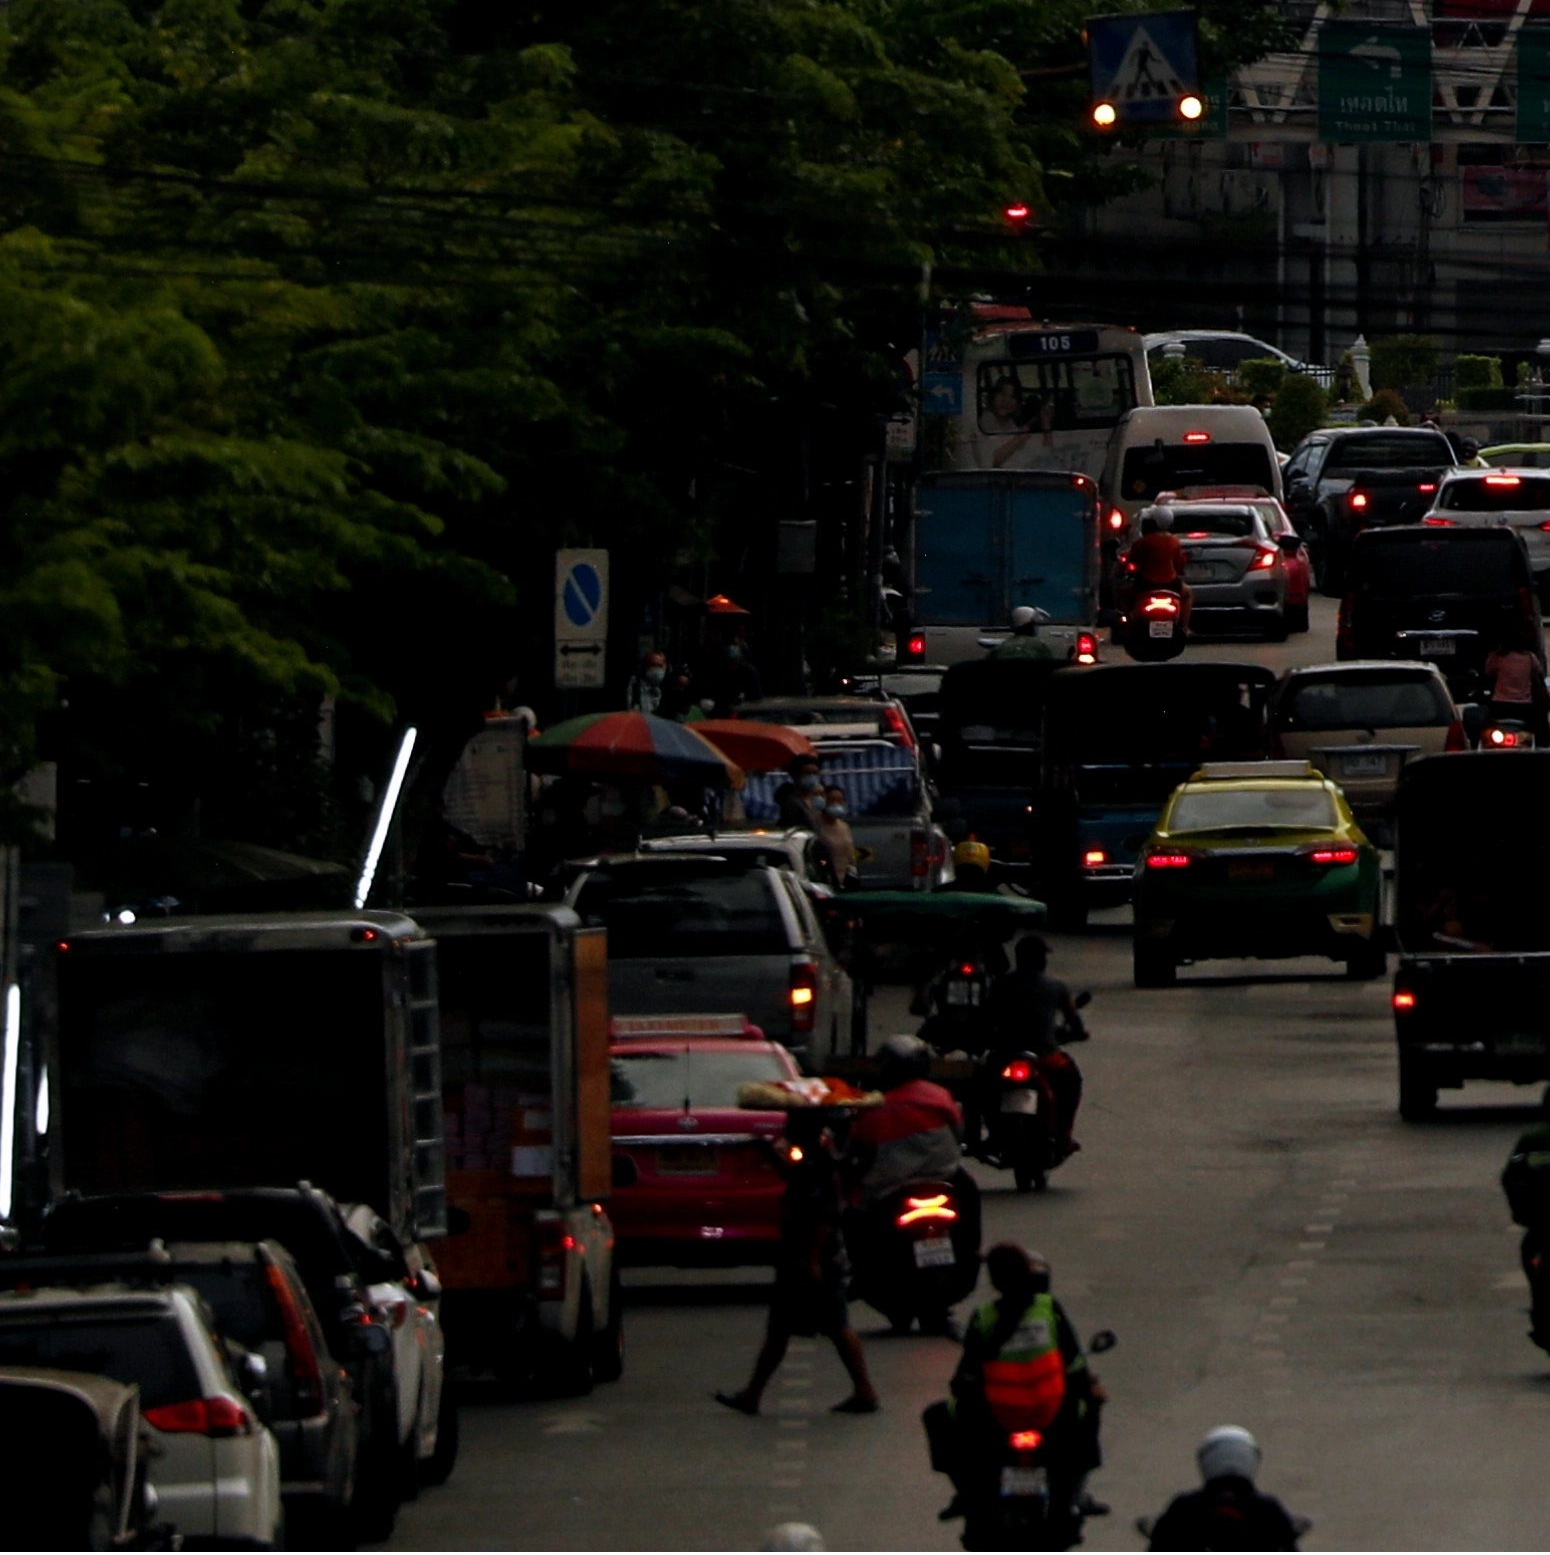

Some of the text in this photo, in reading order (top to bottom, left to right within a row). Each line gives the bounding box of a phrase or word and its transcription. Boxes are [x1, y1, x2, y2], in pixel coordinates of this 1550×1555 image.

[1341, 86, 1408, 114] เทอดไท
[1039, 335, 1071, 351] 105
